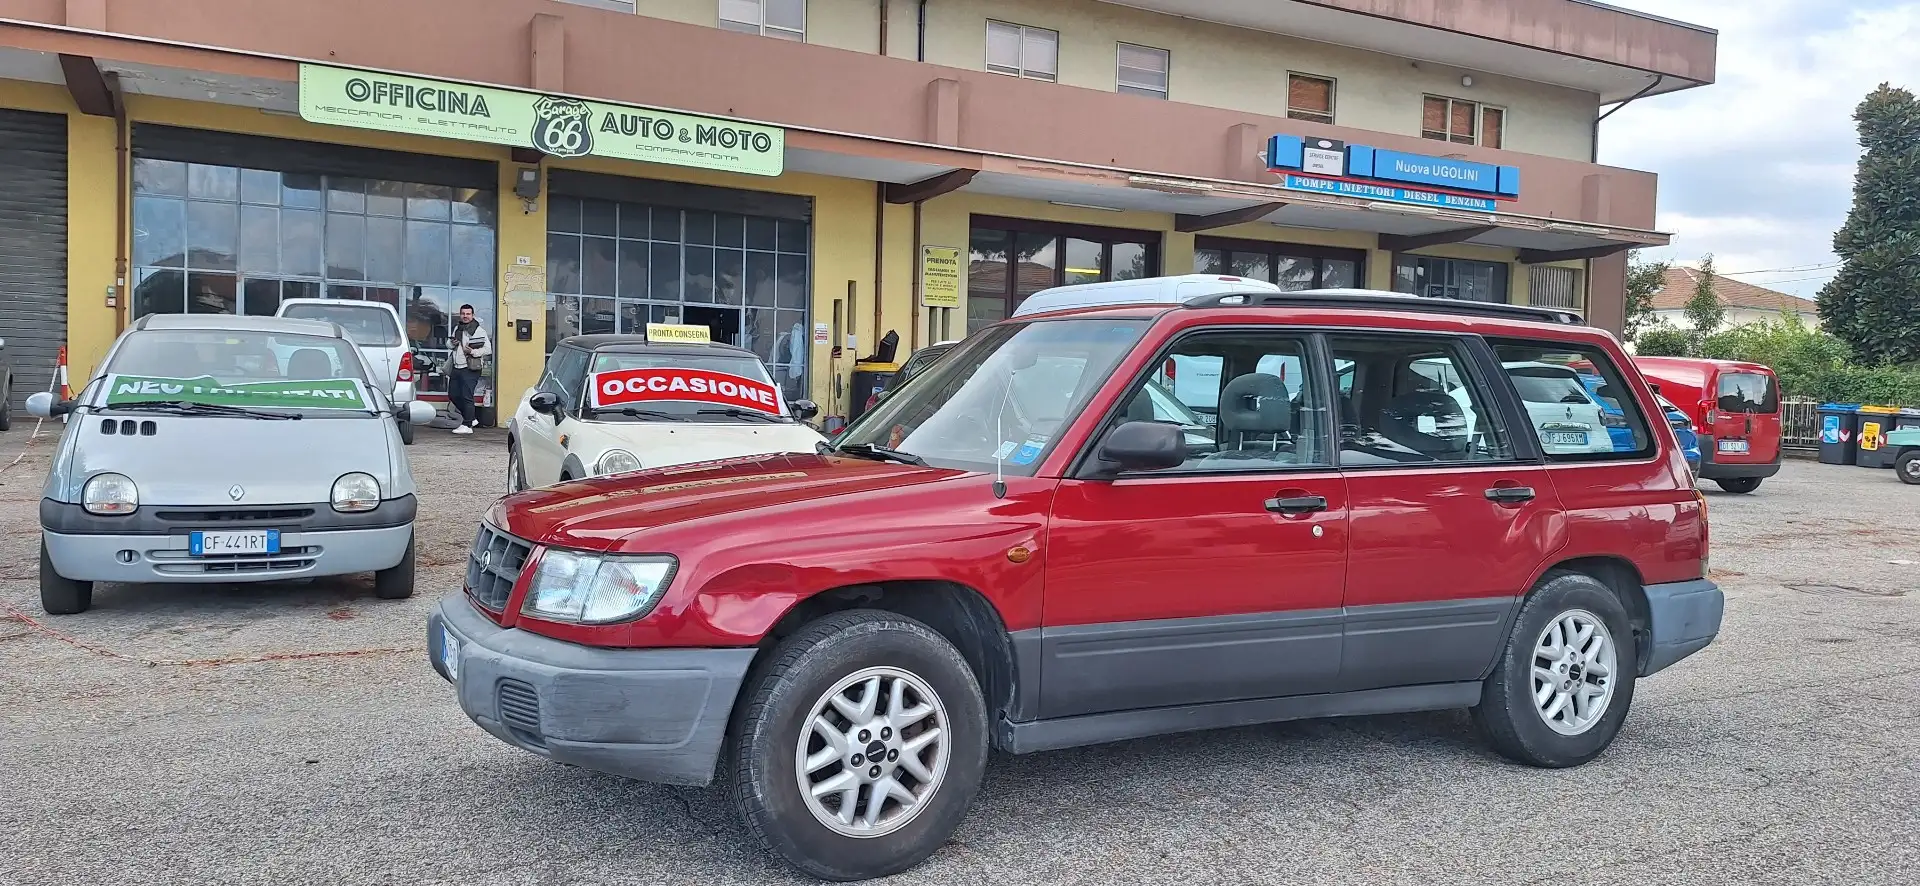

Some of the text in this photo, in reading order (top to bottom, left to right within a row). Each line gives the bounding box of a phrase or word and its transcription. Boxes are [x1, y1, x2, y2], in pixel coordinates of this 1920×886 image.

[345, 77, 491, 118] OFFICINA
[540, 100, 587, 120] Garage
[315, 104, 517, 135] MECCANICA ELETTRAUTO
[544, 118, 583, 150] 66
[600, 112, 772, 153] AUTO & MOTO
[635, 144, 739, 162] COMPRAVENDITA
[1395, 159, 1479, 181] Nuova UGOLINI
[1294, 177, 1486, 208] POMPE INIETTORI DIESEL BENZINA
[926, 257, 957, 265] PRENOTA
[648, 328, 709, 339] PRONTA CONSEGNA
[602, 377, 775, 406] OCCASIONE
